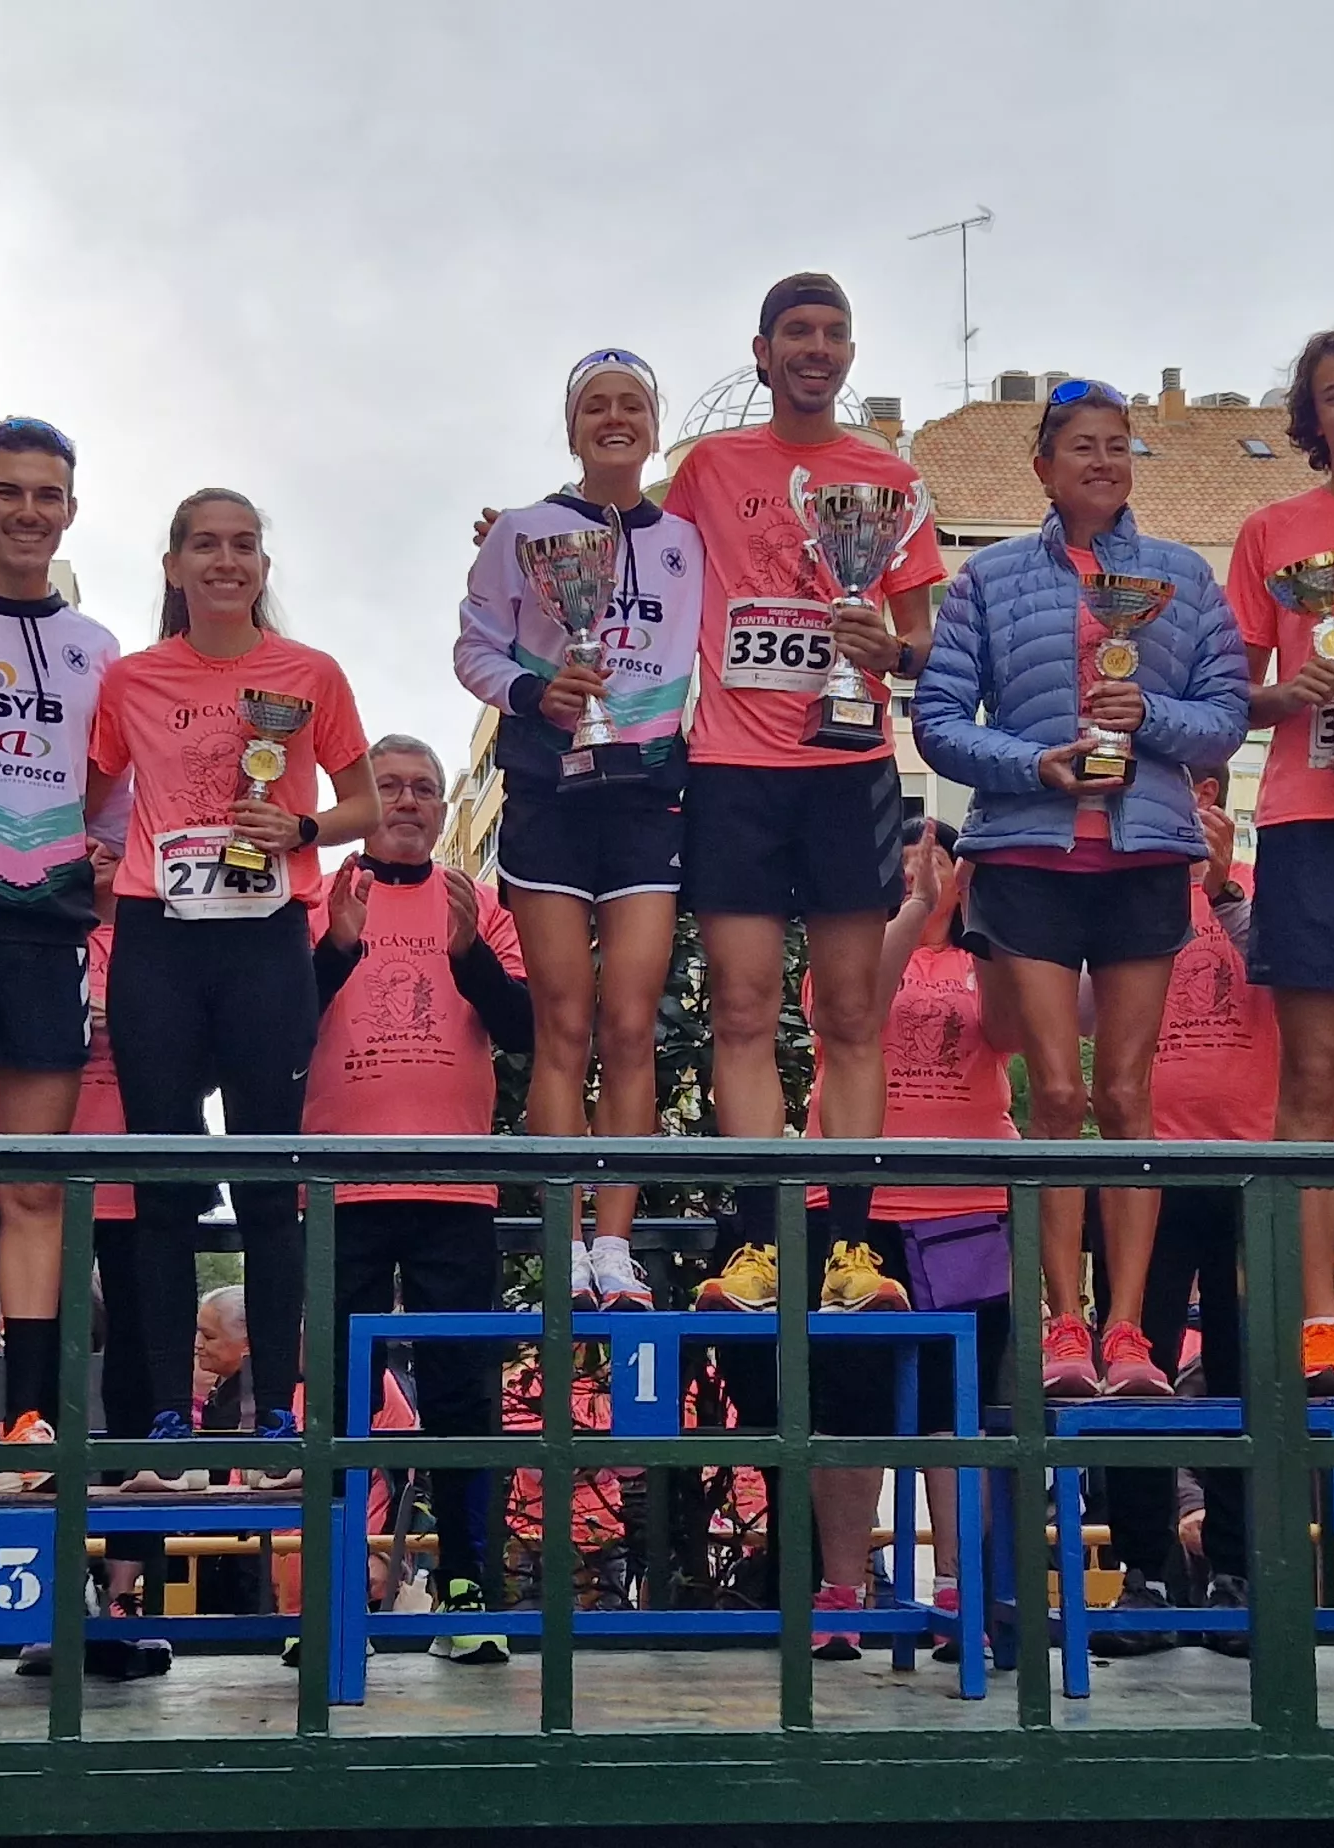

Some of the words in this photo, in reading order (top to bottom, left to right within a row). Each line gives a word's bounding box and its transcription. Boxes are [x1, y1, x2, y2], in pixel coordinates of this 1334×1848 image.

[735, 615, 775, 625] CONTRA
[730, 630, 832, 670] 3365
[606, 657, 663, 677] erosca
[168, 845, 215, 858] CONTRA
[168, 861, 277, 896] 2745
[379, 933, 437, 949] CÁNCER
[627, 1342, 658, 1402] 1
